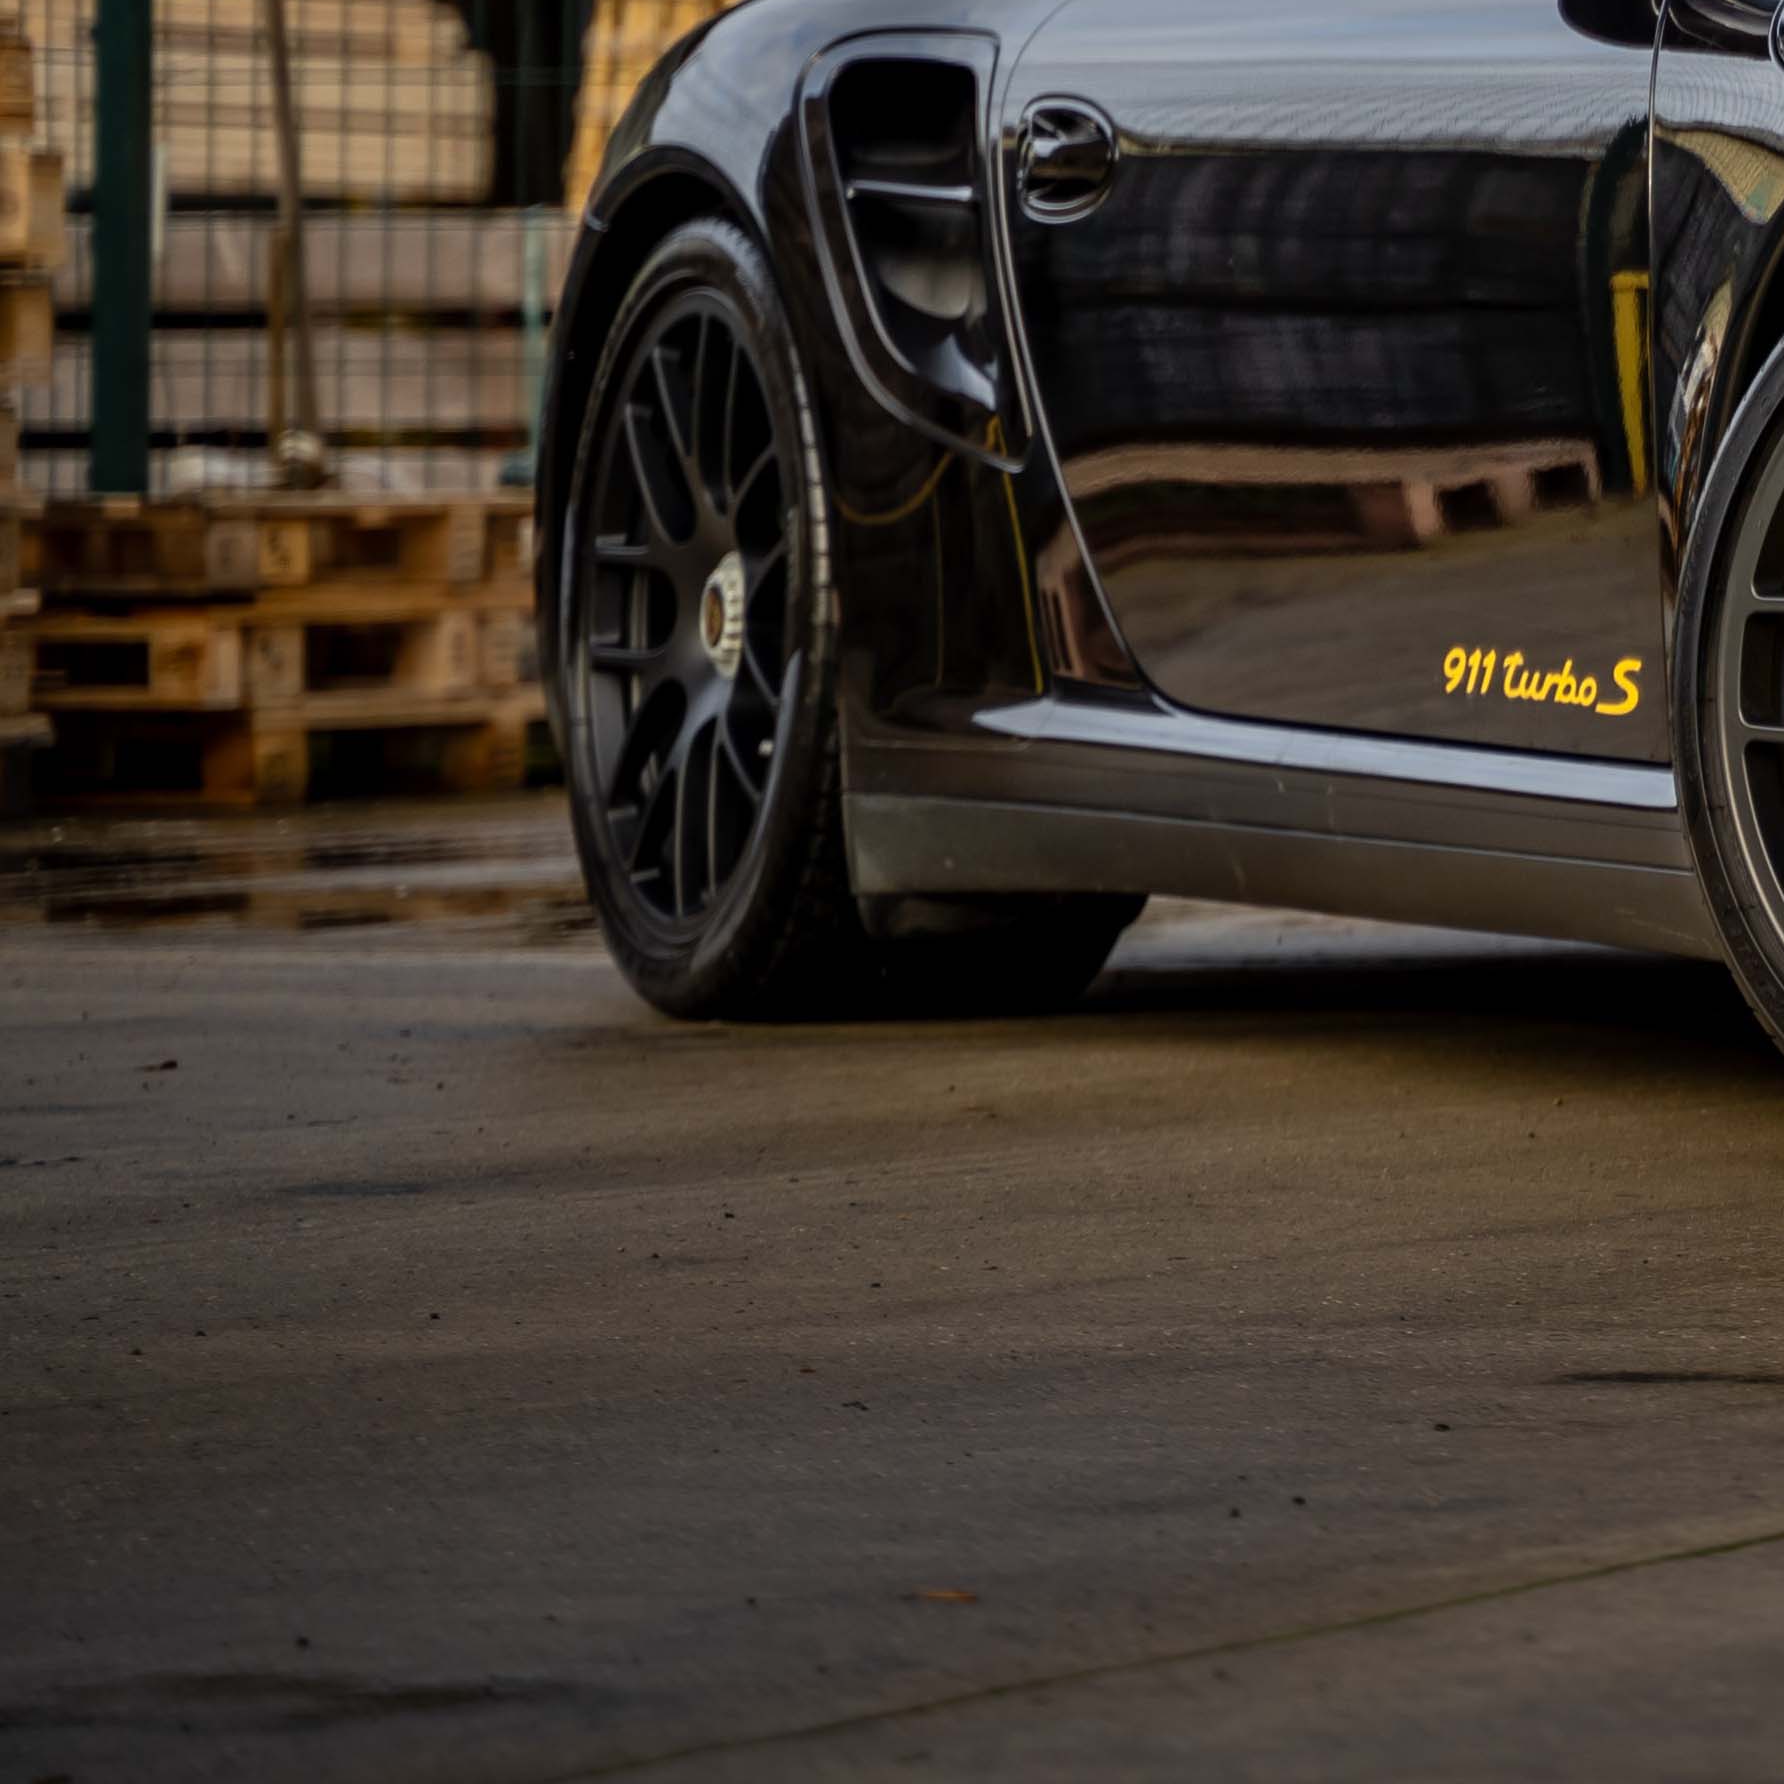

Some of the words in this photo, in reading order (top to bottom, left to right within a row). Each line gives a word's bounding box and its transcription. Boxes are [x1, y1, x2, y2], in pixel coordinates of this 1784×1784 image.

[1443, 646, 1497, 695] 911
[1503, 650, 1597, 707] turbo
[1595, 657, 1642, 716] S
